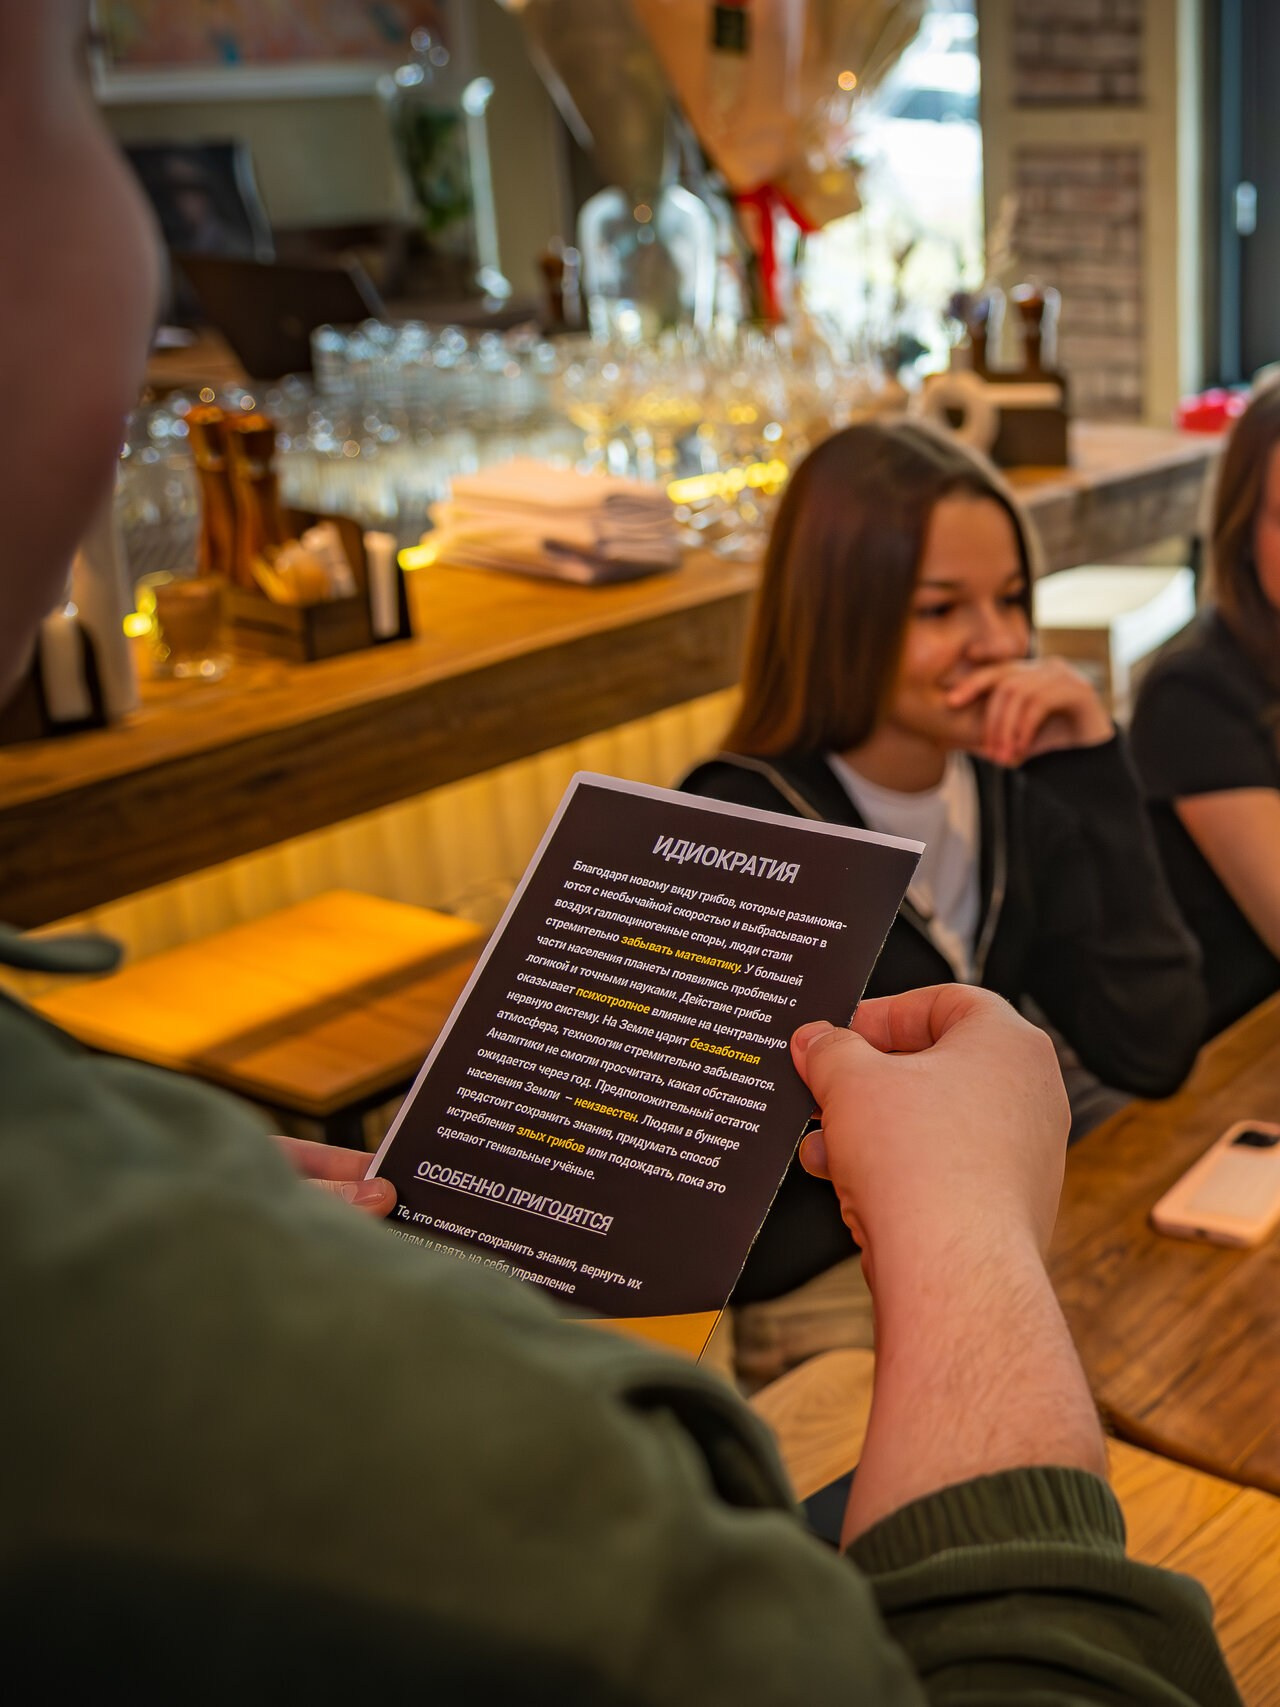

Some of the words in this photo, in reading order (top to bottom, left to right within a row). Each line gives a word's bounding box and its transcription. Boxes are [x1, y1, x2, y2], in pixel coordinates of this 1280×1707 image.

[572, 859, 630, 883] Благодаря
[628, 875, 671, 894] новому
[669, 884, 699, 901] виду
[697, 891, 737, 910] грибов,
[738, 900, 787, 918] которые
[784, 910, 848, 931] размножа-
[652, 834, 801, 884] ИДИОКРАТИЯ
[553, 898, 594, 916] воздух
[592, 907, 690, 939] галлюциногенные
[690, 931, 728, 950] споры,
[728, 940, 761, 956] люди
[760, 948, 794, 963] стали
[563, 880, 592, 894] ются
[591, 887, 600, 896] с
[599, 888, 674, 914] необычайной
[672, 906, 732, 928] скоростью
[731, 920, 741, 930] и
[740, 922, 820, 947] выбрасывают
[819, 939, 828, 949] в
[524, 953, 571, 972] логикой
[569, 964, 579, 975] и
[579, 967, 630, 987] точными
[628, 980, 678, 1000] науками.
[677, 991, 734, 1014] Действие
[732, 1006, 773, 1023] грибов
[536, 935, 568, 951] части
[566, 943, 624, 965] населения
[622, 957, 672, 977] планеты
[670, 969, 730, 991] появились
[730, 984, 789, 1006] проблемы
[788, 998, 798, 1008] с
[545, 917, 620, 943] стремительно
[620, 935, 674, 956] забывать
[674, 949, 743, 975] математику.
[743, 963, 756, 975] У
[753, 965, 804, 987] большей
[505, 990, 554, 1010] нервную
[553, 1003, 601, 1025] систему.
[601, 1013, 618, 1028] На
[618, 1018, 655, 1038] Земле
[654, 1030, 690, 1047] царит
[689, 1037, 761, 1065] беззаботная
[516, 972, 577, 995] оказывает
[575, 987, 651, 1015] психотропное
[650, 1007, 698, 1027] влияние
[697, 1019, 713, 1031] на
[712, 1023, 788, 1050] центральную
[485, 1026, 546, 1052] Аналитики
[544, 1044, 560, 1056] не
[559, 1049, 601, 1067] смогли
[599, 1059, 666, 1087] просчитать,
[666, 1078, 702, 1095] какая
[701, 1087, 768, 1112] обстановка
[496, 1009, 560, 1036] атмосфера,
[562, 1026, 624, 1051] технологии
[623, 1044, 703, 1072] стремительно
[702, 1065, 776, 1092] забываются.
[456, 1086, 516, 1110] предстоит
[514, 1103, 572, 1126] сохранить
[572, 1119, 614, 1141] знания,
[615, 1132, 678, 1157] придумать
[679, 1150, 722, 1168] способ
[466, 1066, 524, 1090] населения
[523, 1081, 561, 1101] Земли
[573, 1097, 639, 1124] неизвестен.
[640, 1114, 685, 1136] Людям
[684, 1128, 694, 1138] в
[693, 1128, 741, 1151] бункере
[477, 1048, 538, 1072] ожидается
[538, 1064, 571, 1081] через
[569, 1074, 593, 1089] год.
[594, 1078, 715, 1121] Предположительный
[713, 1113, 761, 1134] остаток
[436, 1125, 487, 1147] сделают
[484, 1139, 552, 1167] гениальные
[549, 1159, 596, 1180] учёные.
[446, 1105, 517, 1134] истребления
[515, 1126, 548, 1143] злых
[545, 1134, 586, 1154] грибов
[585, 1146, 609, 1161] или
[607, 1152, 675, 1182] подождать,
[676, 1172, 706, 1189] пока
[705, 1180, 727, 1194] это
[414, 1160, 506, 1199] ОСОБЕННО
[504, 1186, 615, 1232] ПРИГОДЯТСЯ
[397, 1204, 411, 1221] Те,
[412, 1211, 433, 1225] кто
[433, 1218, 479, 1239] сможет
[477, 1232, 535, 1257] сохранить
[535, 1250, 578, 1273] знания,
[579, 1263, 626, 1285] вернуть
[626, 1277, 643, 1290] их
[483, 1258, 510, 1275] себя
[508, 1266, 576, 1294] управление
